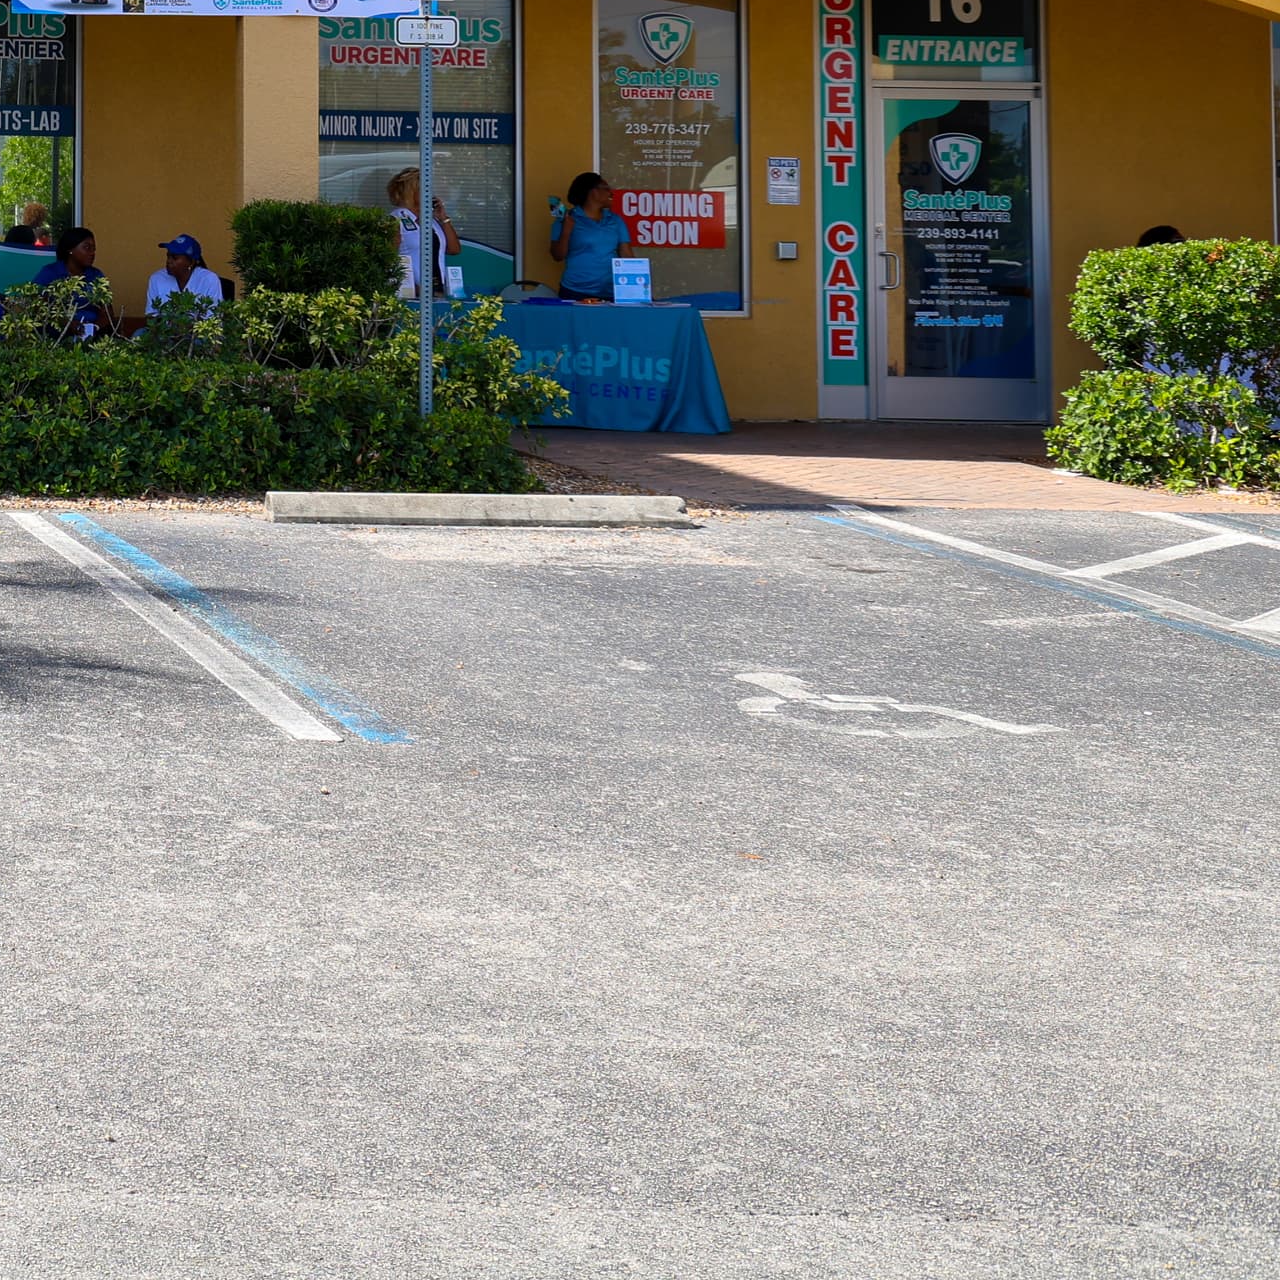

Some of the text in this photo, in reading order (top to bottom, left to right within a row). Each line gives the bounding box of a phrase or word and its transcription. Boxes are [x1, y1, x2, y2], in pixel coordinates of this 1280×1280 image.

[885, 38, 1018, 63] ENTRANCE
[614, 66, 720, 88] SantéPlus
[620, 88, 714, 101] URGENT CARE
[320, 114, 357, 136] MINOR
[361, 116, 403, 137] INJURY
[453, 118, 469, 138] ON
[473, 118, 498, 139] SITE
[625, 123, 711, 136] 239-776-3477
[621, 192, 714, 218] COMING
[903, 188, 1013, 211] SantéPlus
[903, 210, 1012, 223] MEDICAL CENTER
[636, 220, 699, 246] SOON
[917, 228, 999, 240] 239-893-4141
[824, 220, 860, 361] CARE
[512, 343, 673, 383] antéPlus
